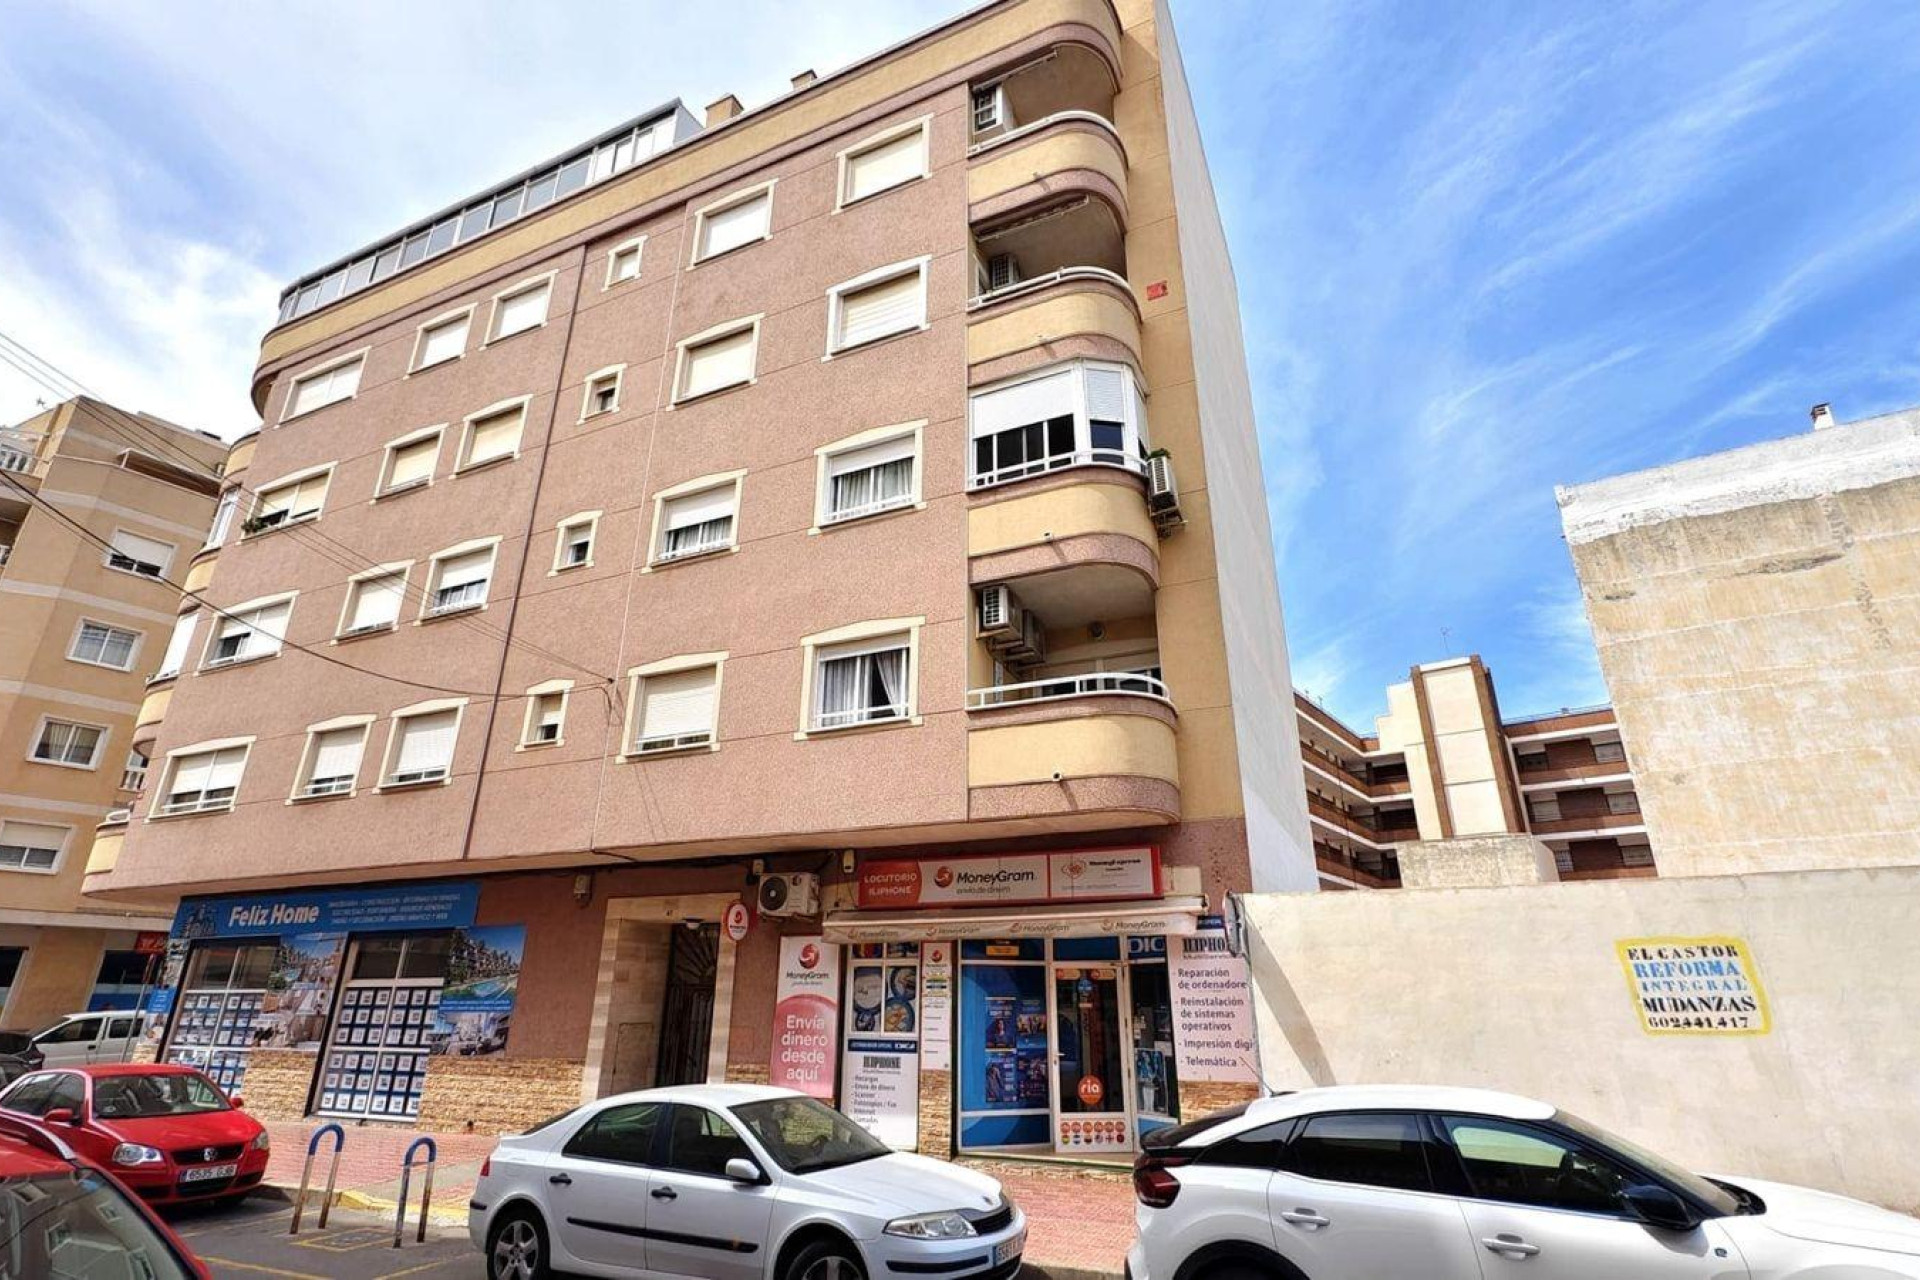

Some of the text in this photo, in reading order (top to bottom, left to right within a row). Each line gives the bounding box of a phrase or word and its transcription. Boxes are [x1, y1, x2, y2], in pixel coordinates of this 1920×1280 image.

[864, 872, 917, 884] LOCUTORIO
[956, 871, 1034, 885] MoneyGram
[229, 906, 267, 927] Feliz
[270, 904, 320, 925] Home
[1116, 921, 1166, 930] MoneyGram
[1627, 945, 1738, 960] EL CASTOR
[1178, 968, 1230, 978] Reparación
[1634, 960, 1741, 978] REFORMA
[786, 971, 830, 981] MoneyGram
[1178, 980, 1190, 990] de
[1642, 980, 1747, 992] INTEGRAL
[1180, 997, 1244, 1006] Reinstalación
[1643, 996, 1756, 1012] MUDANZAS
[1180, 1009, 1235, 1019] de sistemas
[786, 1015, 825, 1029] Envía
[1181, 1023, 1232, 1033] operativos
[781, 1033, 828, 1046] dinero
[1184, 1038, 1232, 1049] Impresión
[781, 1049, 825, 1063] desde
[1186, 1056, 1237, 1067] Telemática
[786, 1066, 819, 1083] aquí
[1081, 1080, 1099, 1093] ria
